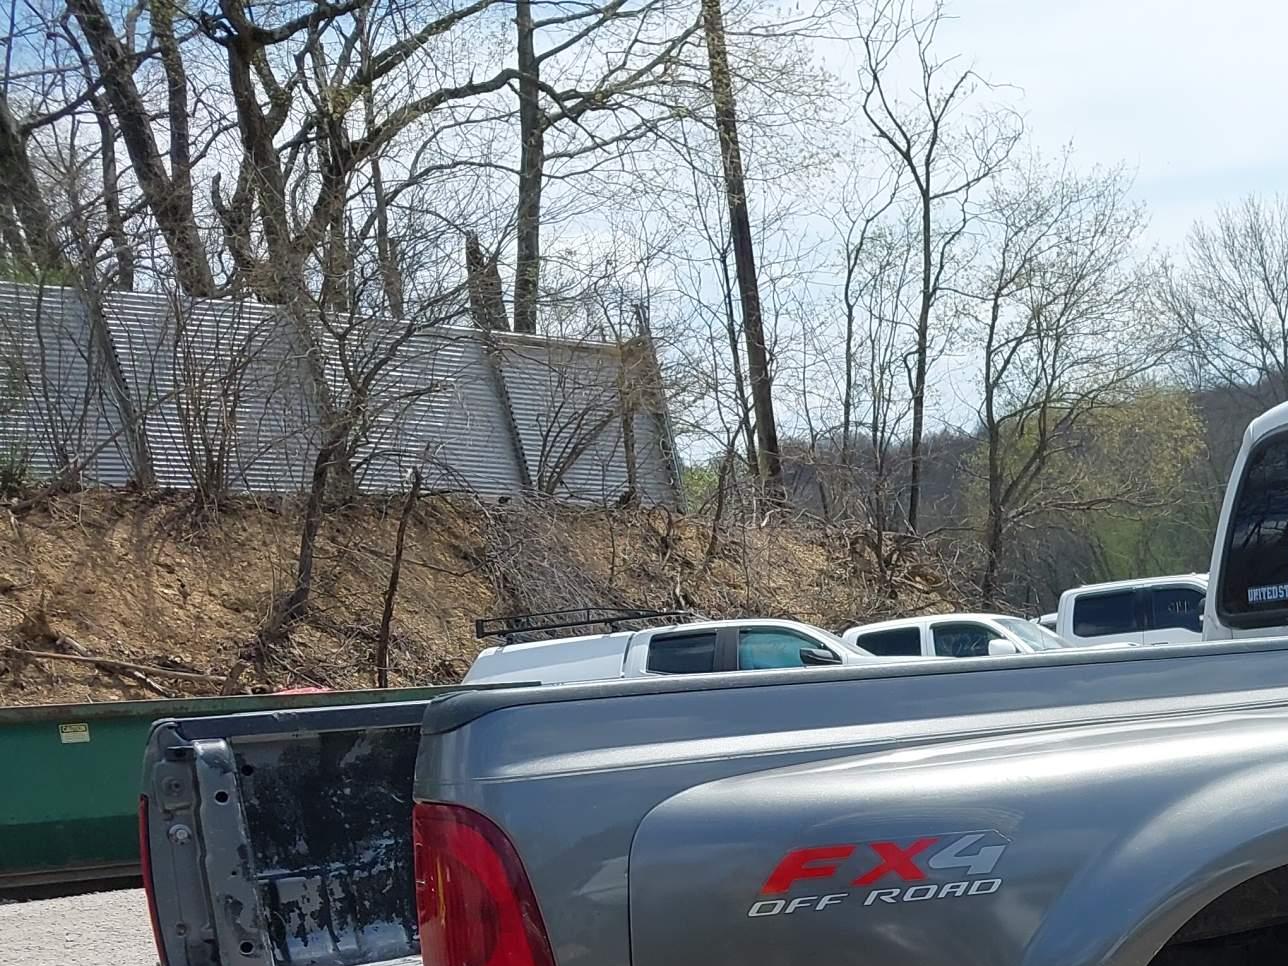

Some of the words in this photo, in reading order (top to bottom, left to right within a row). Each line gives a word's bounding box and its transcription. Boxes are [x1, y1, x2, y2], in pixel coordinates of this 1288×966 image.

[1247, 586, 1278, 602] UNITED
[760, 832, 1007, 896] FX4
[748, 893, 849, 917] OFF
[863, 878, 1003, 906] ROAD
